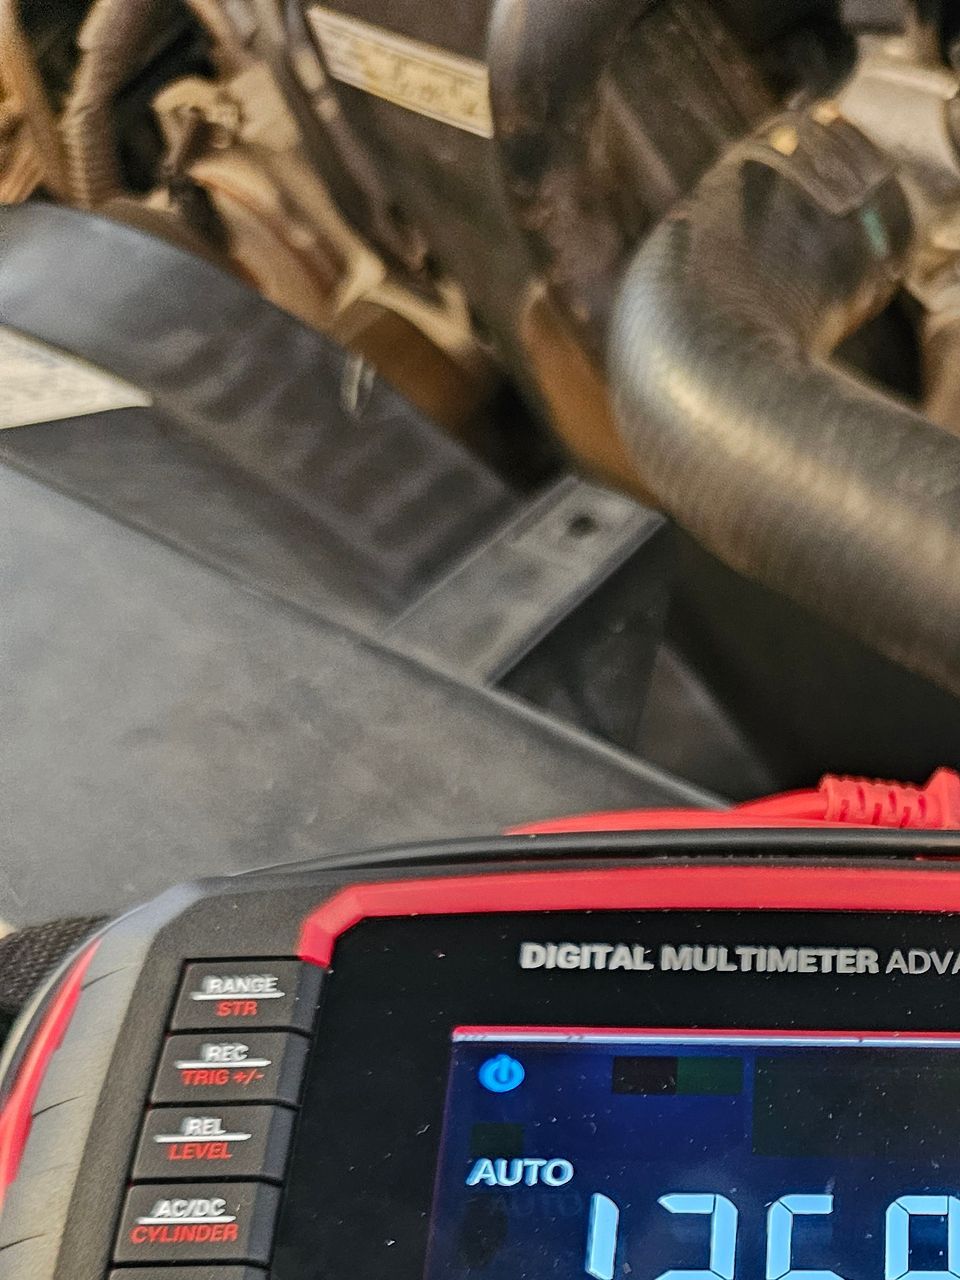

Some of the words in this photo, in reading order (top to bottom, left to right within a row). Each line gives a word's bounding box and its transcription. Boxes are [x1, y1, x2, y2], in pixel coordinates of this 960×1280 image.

[520, 943, 655, 971] DIGITAL
[660, 945, 879, 974] MULTIMETER
[202, 974, 279, 993] RANGE
[216, 1000, 258, 1017] STR
[202, 1043, 249, 1061] REC
[181, 1068, 229, 1086] TRIG
[183, 1117, 227, 1135] REL
[168, 1142, 233, 1161] LEVEL
[465, 1158, 574, 1187] AUTO
[152, 1198, 227, 1218] AC/DC
[131, 1223, 240, 1244] CYLINDER
